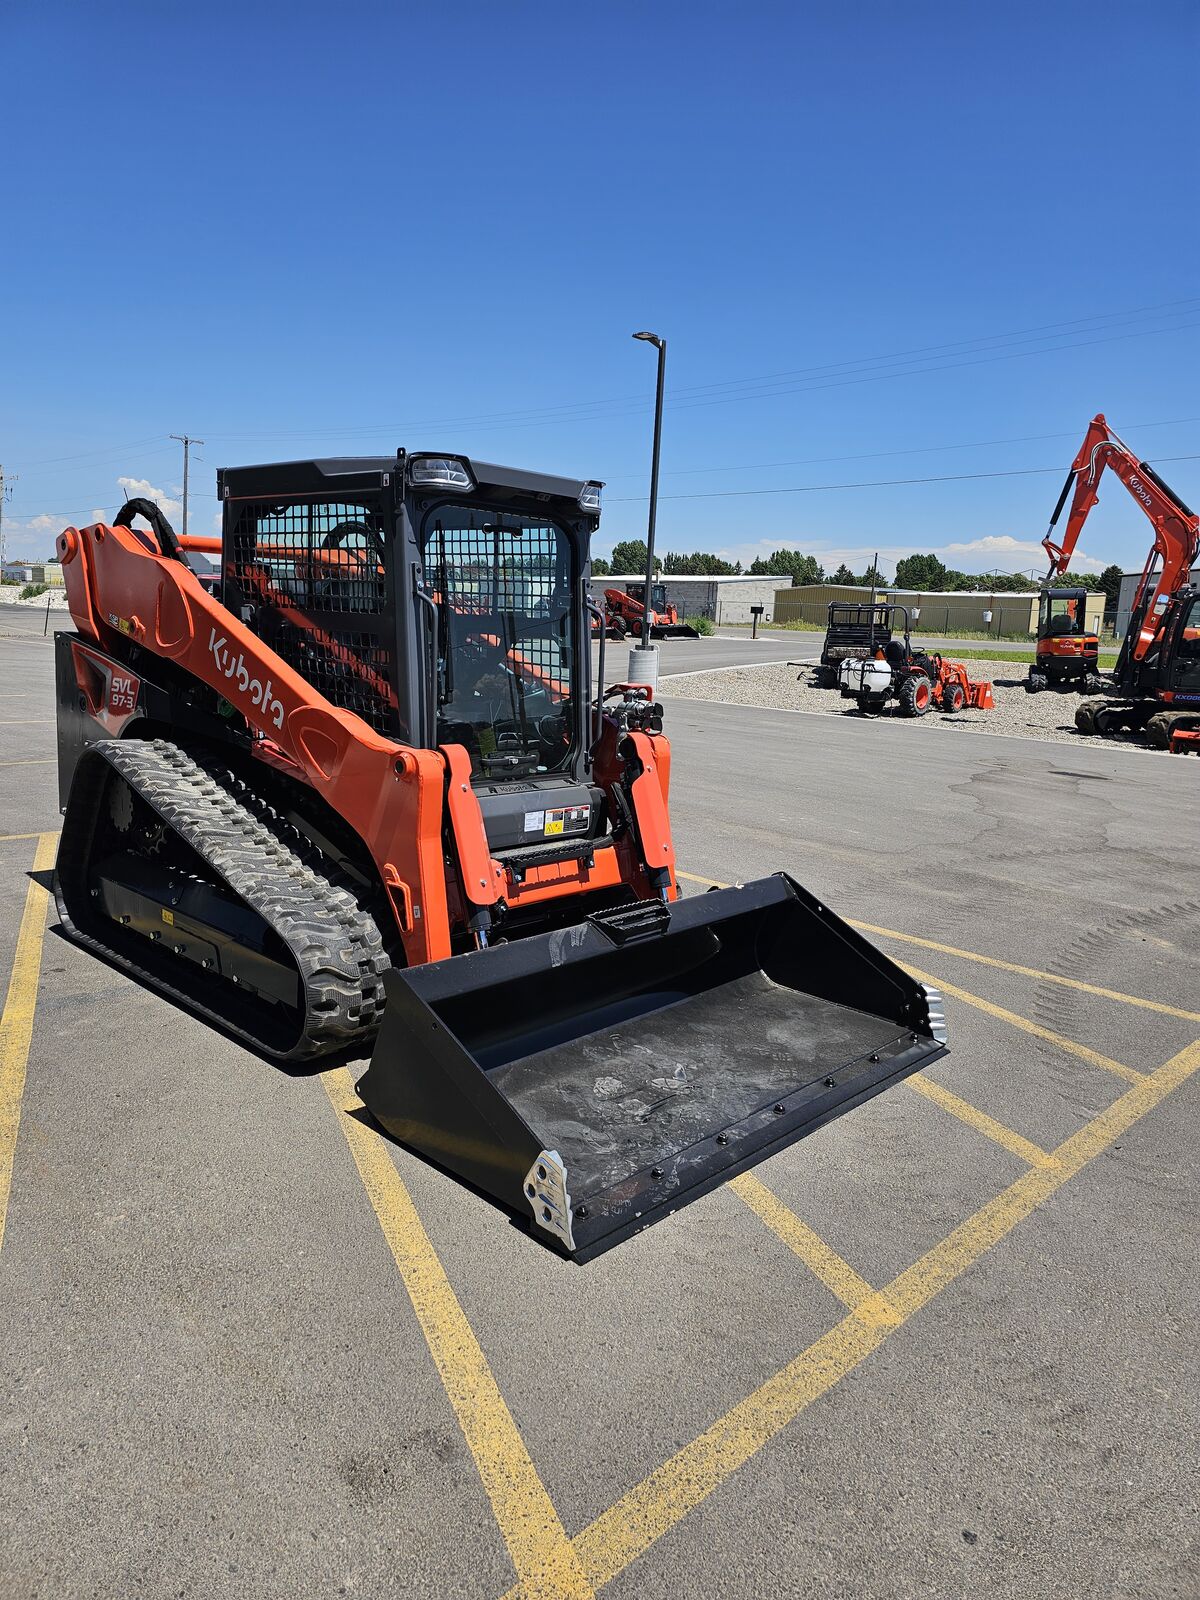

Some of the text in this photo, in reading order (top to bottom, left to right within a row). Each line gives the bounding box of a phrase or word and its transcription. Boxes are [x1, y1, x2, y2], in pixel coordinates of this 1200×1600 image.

[1129, 474, 1152, 507] Kubota
[111, 677, 135, 695] SVL
[208, 627, 285, 730] Kubota
